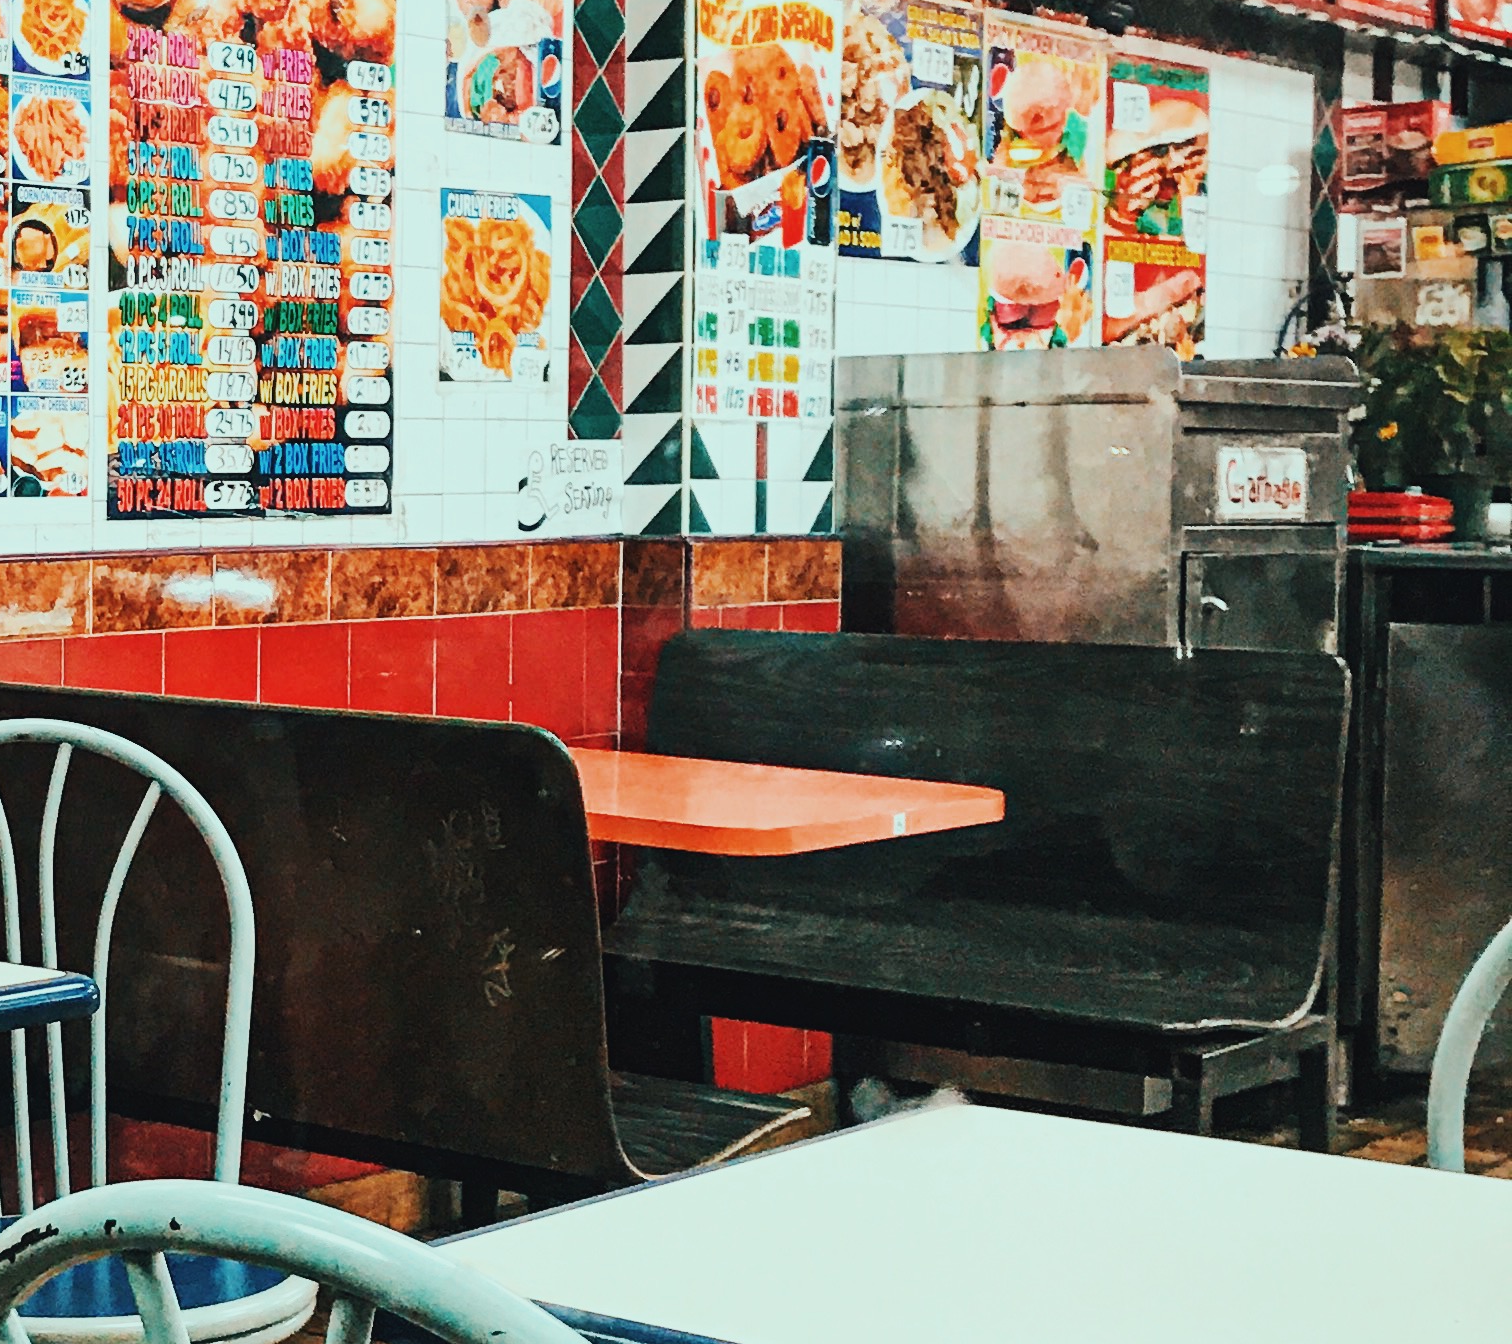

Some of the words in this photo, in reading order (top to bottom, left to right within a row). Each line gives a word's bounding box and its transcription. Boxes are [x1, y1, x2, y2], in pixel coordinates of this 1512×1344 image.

[13, 80, 38, 94] SWEET
[39, 83, 66, 97] POTATO
[128, 142, 137, 176] 5
[139, 142, 158, 177] PC
[159, 146, 168, 178] 2
[171, 145, 203, 181] ROLL
[280, 157, 314, 192] FRIES
[447, 192, 484, 219] CURLY
[486, 195, 520, 221] FRIES
[126, 216, 137, 249] 7
[139, 217, 158, 252] PC
[159, 220, 169, 253] 3
[171, 220, 205, 255] ROLL
[281, 228, 305, 263] BOX
[309, 230, 341, 264] FRIES
[119, 329, 135, 364] 12
[137, 329, 156, 364] PC
[158, 332, 168, 364] 5
[171, 330, 203, 365] ROLL
[277, 335, 301, 369] BOX
[305, 337, 337, 370] FRIES
[550, 443, 608, 475] RESERVED
[1226, 458, 1302, 510] Garbage
